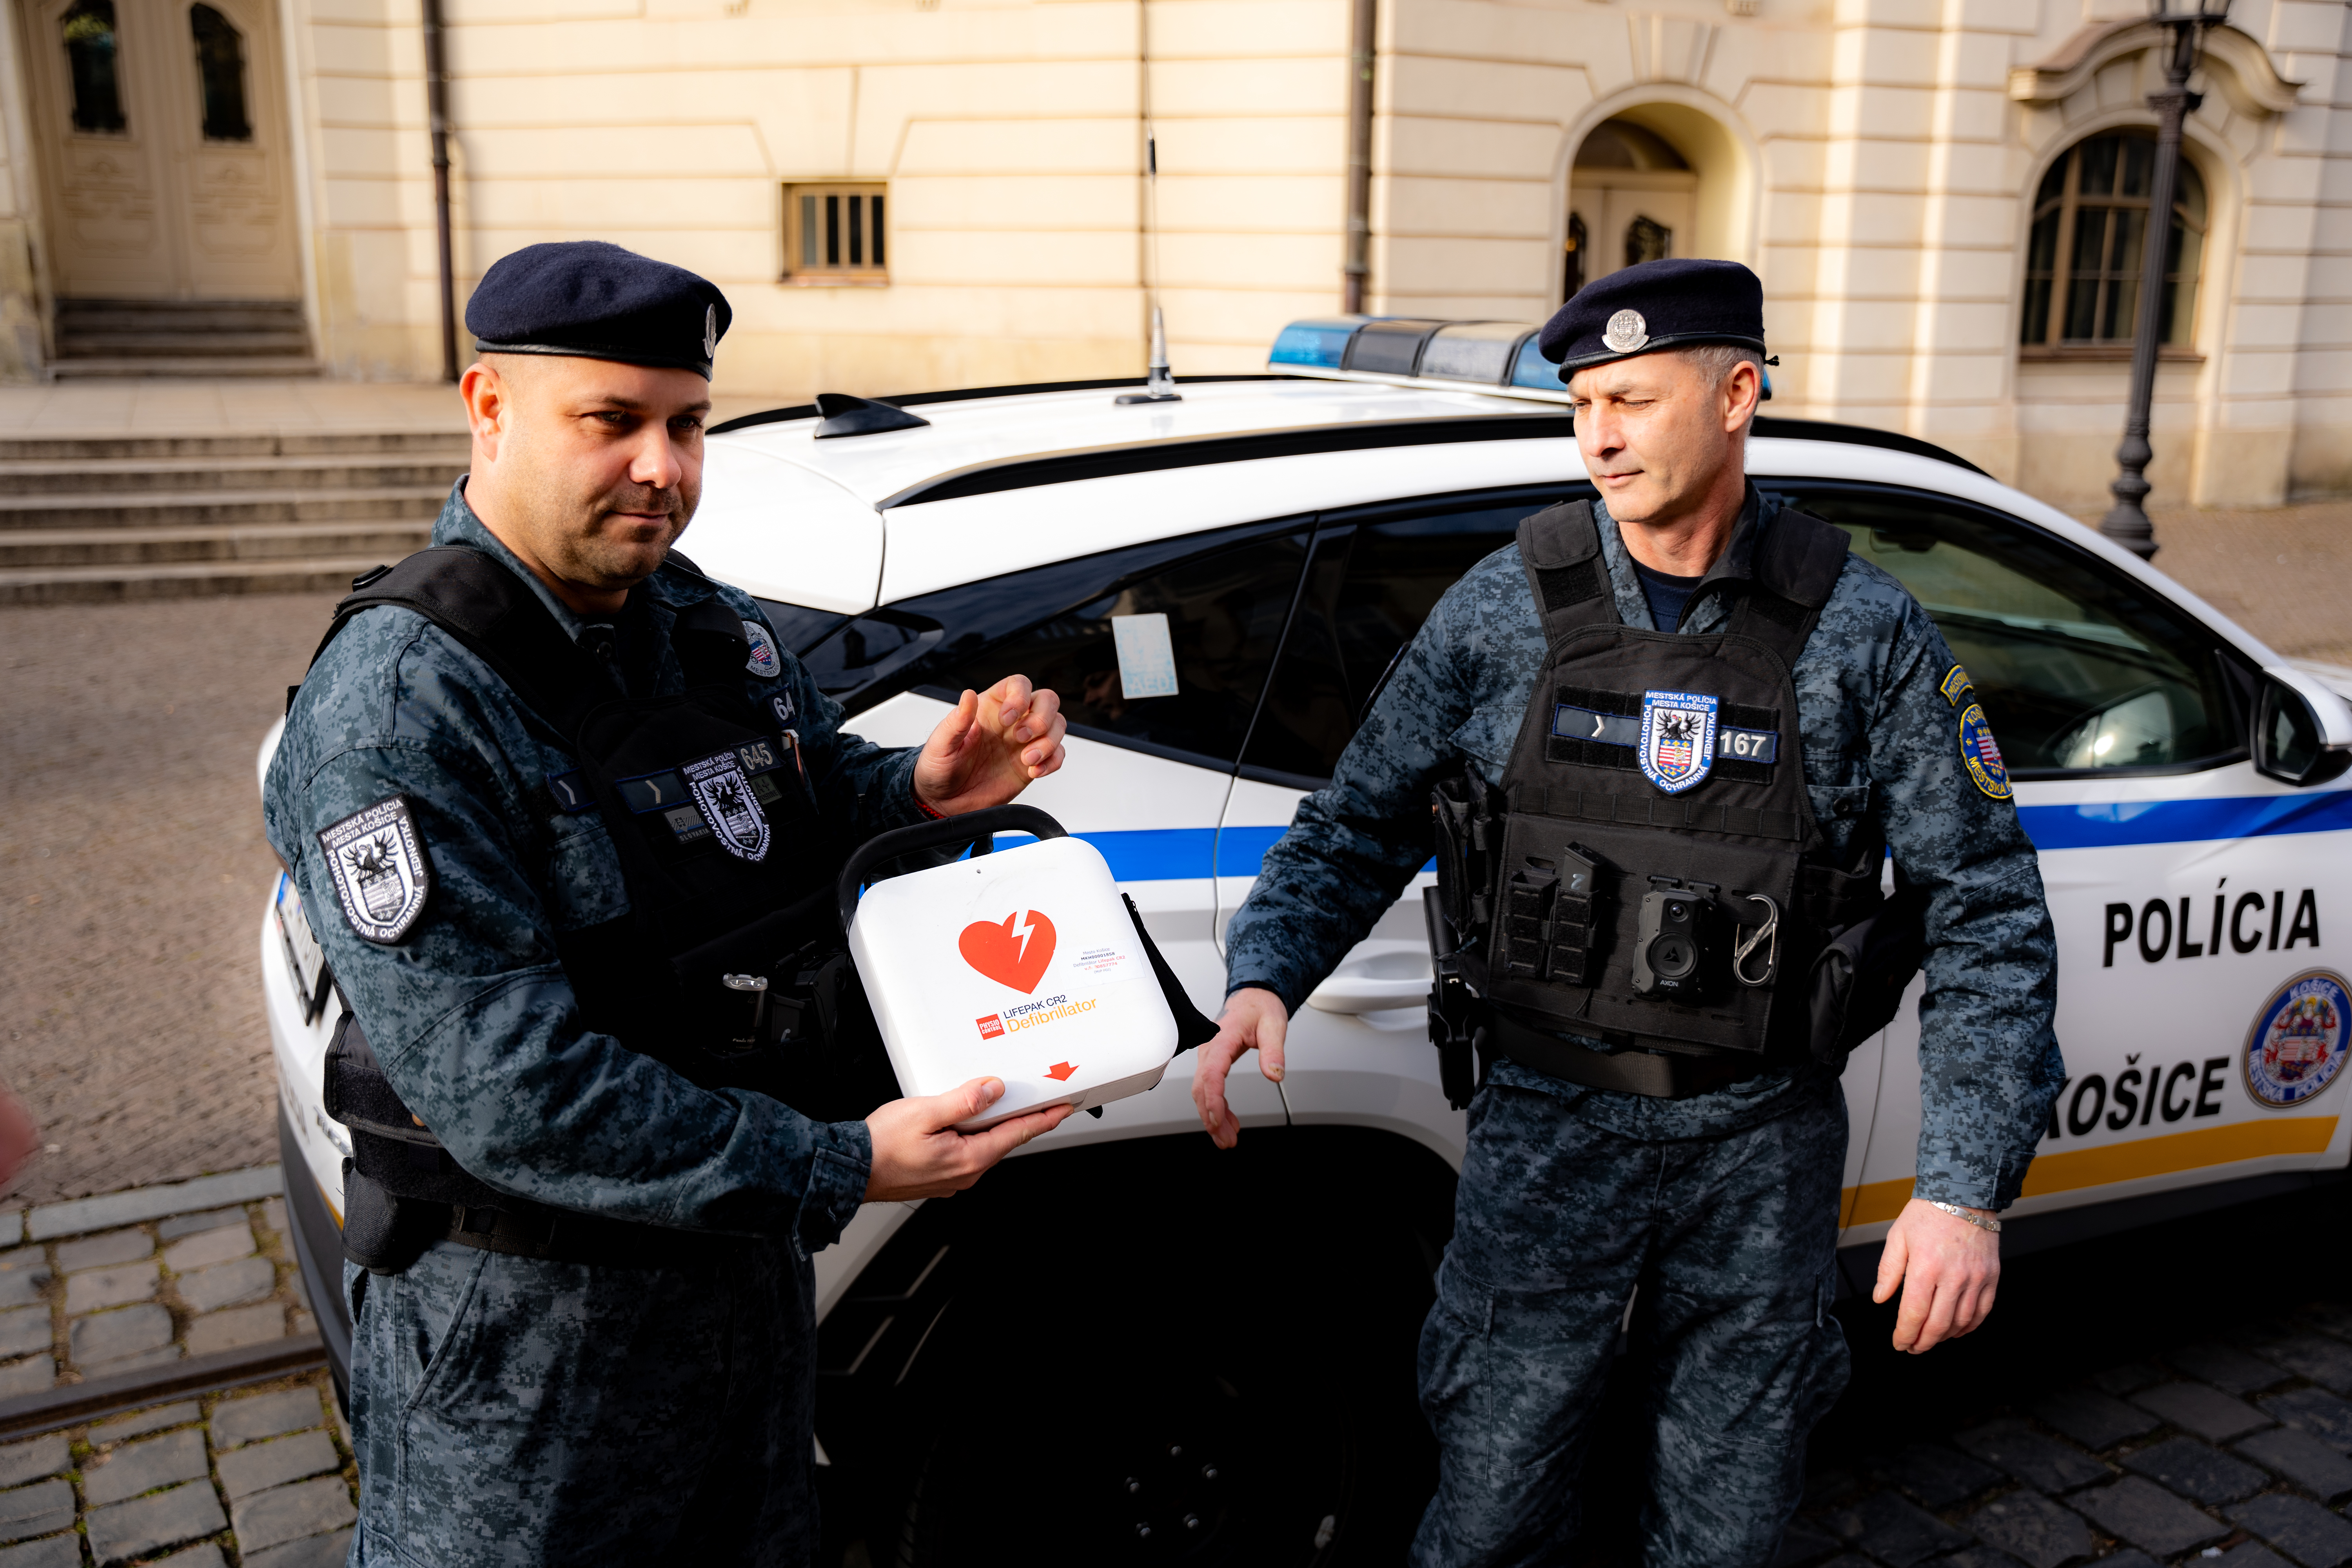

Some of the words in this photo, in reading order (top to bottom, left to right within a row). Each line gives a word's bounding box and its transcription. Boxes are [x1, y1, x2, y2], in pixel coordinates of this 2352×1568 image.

[1646, 692, 1685, 701] MESTSKÁ
[1686, 695, 1717, 705] POLÍCIA
[1651, 699, 1680, 708] MESTA
[1680, 702, 1710, 711] KOŠICE
[740, 743, 773, 770] 645
[1639, 705, 1659, 780] POHOTOVOSTNÁ
[1659, 764, 1708, 791] OCHRANNÁ
[1703, 711, 1716, 760] JEDNOTKA
[1720, 731, 1766, 756] 167
[682, 757, 715, 775] MESTSKÁ
[715, 752, 737, 763] POLÍCIA
[692, 769, 714, 781] MESTA
[715, 760, 736, 773] KOŠICE
[1969, 756, 2006, 794] MESTSKÁ
[737, 766, 765, 817] JEDNOTKA
[322, 813, 365, 844] MESTSKÁ
[365, 799, 403, 822] POLÍCIA
[332, 830, 361, 848] MESTA
[361, 811, 398, 834] KOŠICE
[679, 828, 710, 841] SLOVAKIA
[689, 782, 744, 857] POHOTOVOSTNÁ
[399, 815, 423, 878] JEDNOTKA
[748, 823, 770, 861] OCHRANNÁ
[327, 849, 376, 936] POHOTOVOSTNÁ
[379, 885, 425, 937] OCHRANNÁ
[2102, 875, 2320, 968] POLÍCIA
[1081, 952, 1115, 961] MKH00001858
[2289, 977, 2340, 1000] KOŠICE
[1003, 1001, 1045, 1019] LIFEPAK
[1046, 995, 1067, 1006] CR2
[1006, 998, 1096, 1033] Defibrillator
[979, 1019, 1000, 1030] PHYSIO
[981, 1025, 1002, 1034] CONTROL
